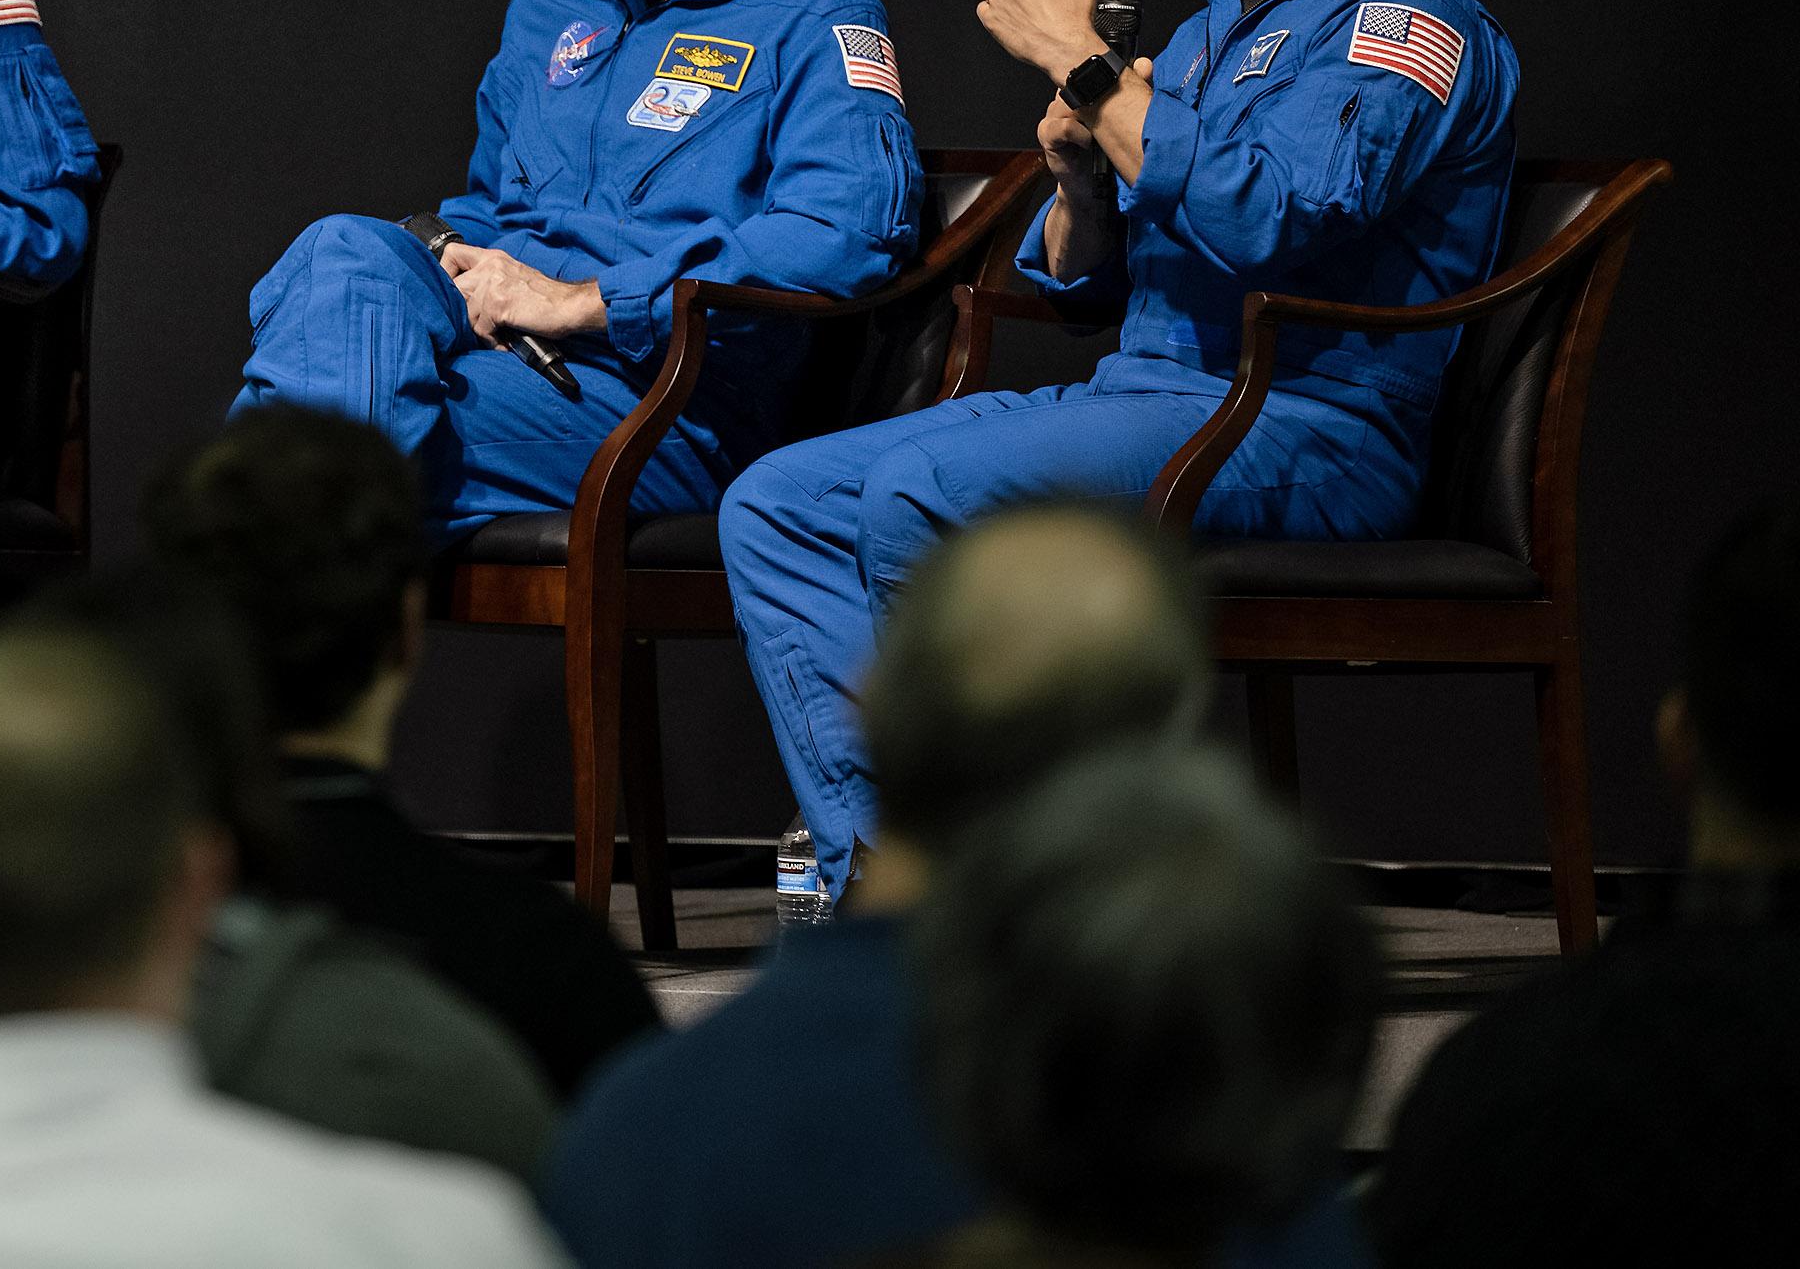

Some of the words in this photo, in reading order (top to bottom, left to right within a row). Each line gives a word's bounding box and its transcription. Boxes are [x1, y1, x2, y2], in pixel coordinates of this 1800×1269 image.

[671, 64, 695, 77] STEVE
[696, 68, 726, 84] BOWEN
[635, 86, 698, 124] 25
